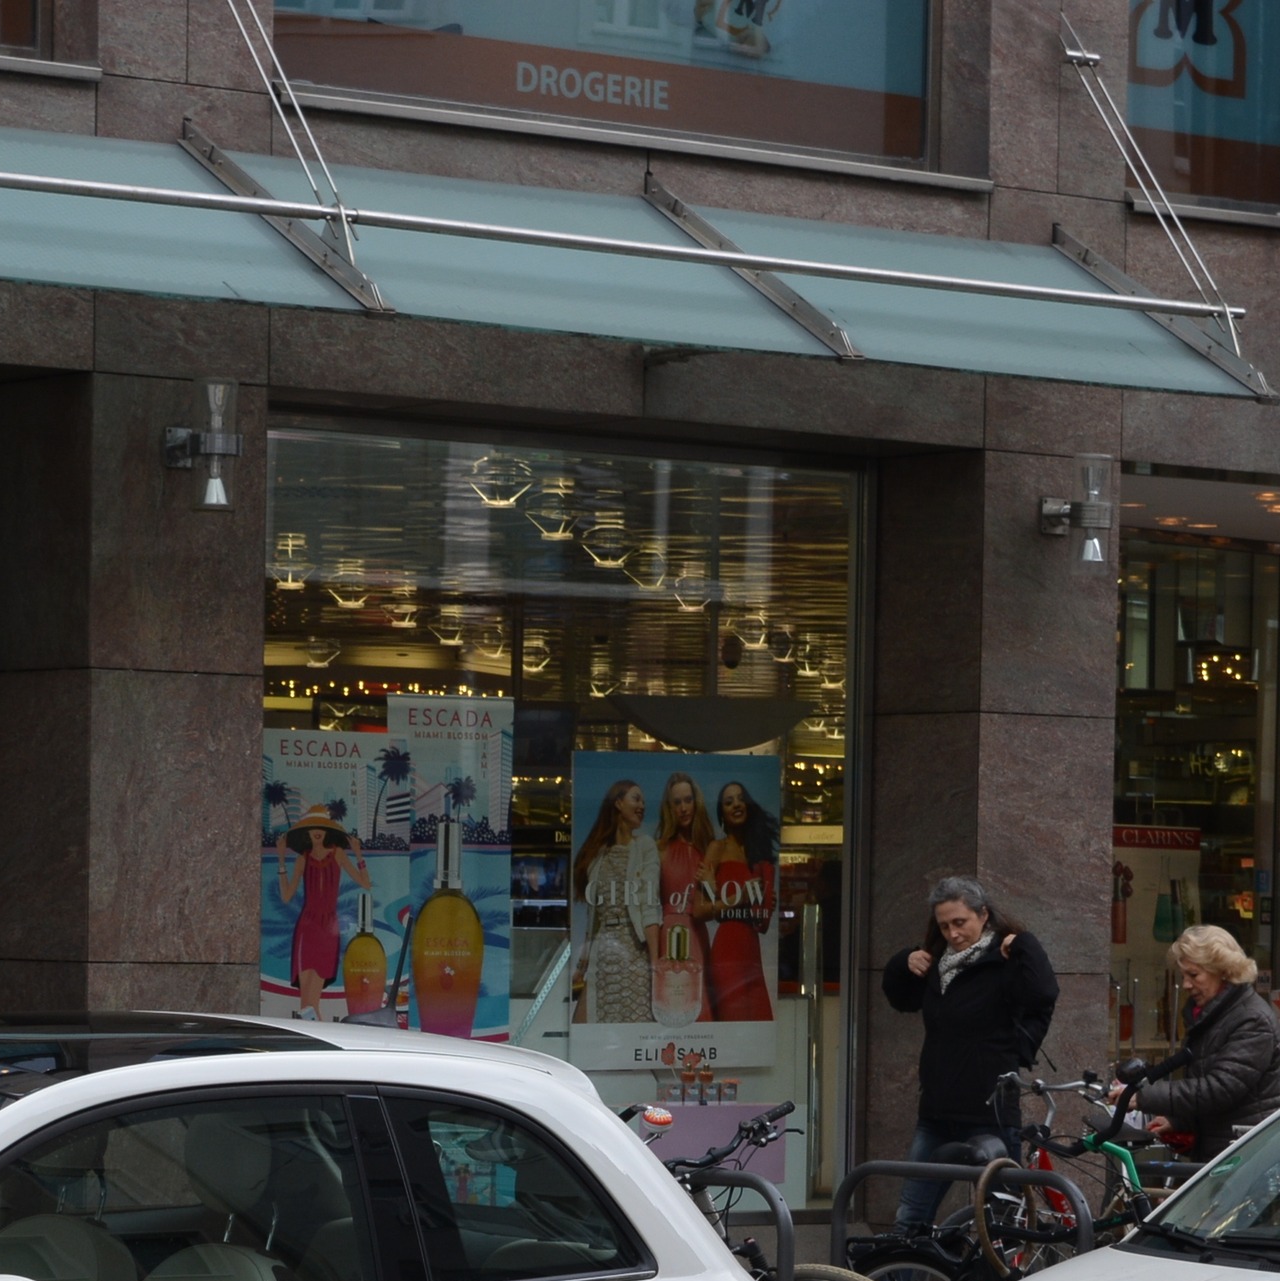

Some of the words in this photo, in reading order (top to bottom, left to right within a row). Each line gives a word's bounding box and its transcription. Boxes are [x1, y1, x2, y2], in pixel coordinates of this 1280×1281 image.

[514, 60, 670, 112] DROGERIE
[408, 707, 494, 728] ESCADA
[413, 730, 446, 741] MIAMI
[446, 731, 489, 742] BLOSSOM
[279, 738, 362, 759] ESCADA
[285, 760, 315, 770] MIAMI
[317, 760, 358, 771] BLOSSOM
[1121, 828, 1195, 847] CLARINS
[584, 880, 661, 908] GIRL
[669, 881, 696, 913] of
[699, 880, 770, 908] NOW
[719, 907, 770, 921] FOREVER
